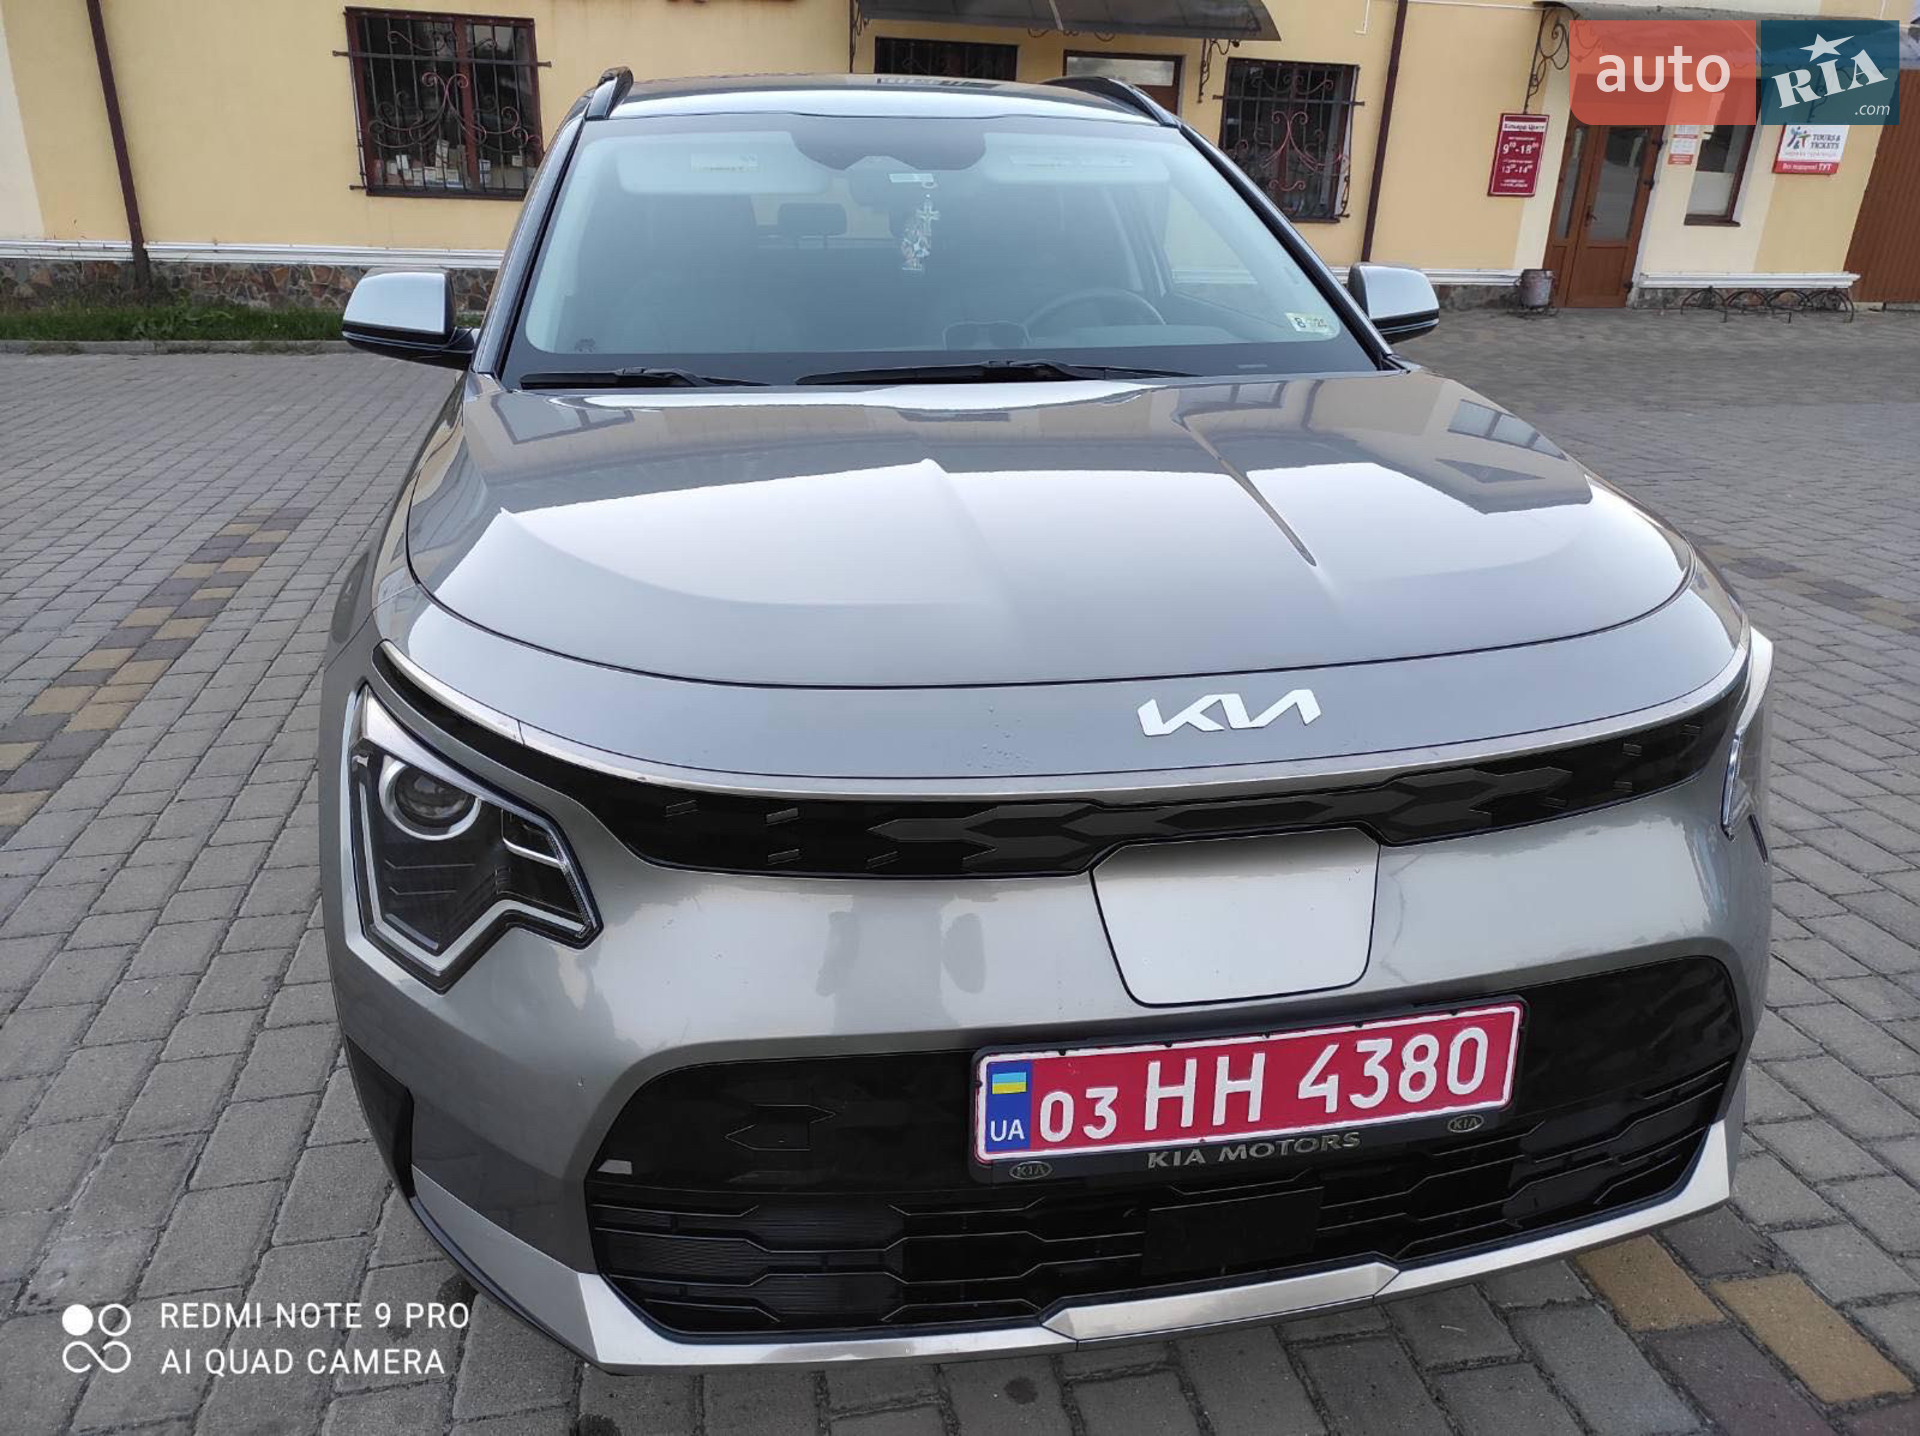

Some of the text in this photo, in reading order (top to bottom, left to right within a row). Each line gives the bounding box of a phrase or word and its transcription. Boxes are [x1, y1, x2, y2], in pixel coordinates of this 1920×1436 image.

[1137, 689, 1322, 737] KIA
[1038, 1026, 1489, 1143] 03 HH 4380
[989, 1119, 1026, 1143] UA
[1146, 1131, 1362, 1170] KIA MOTORS
